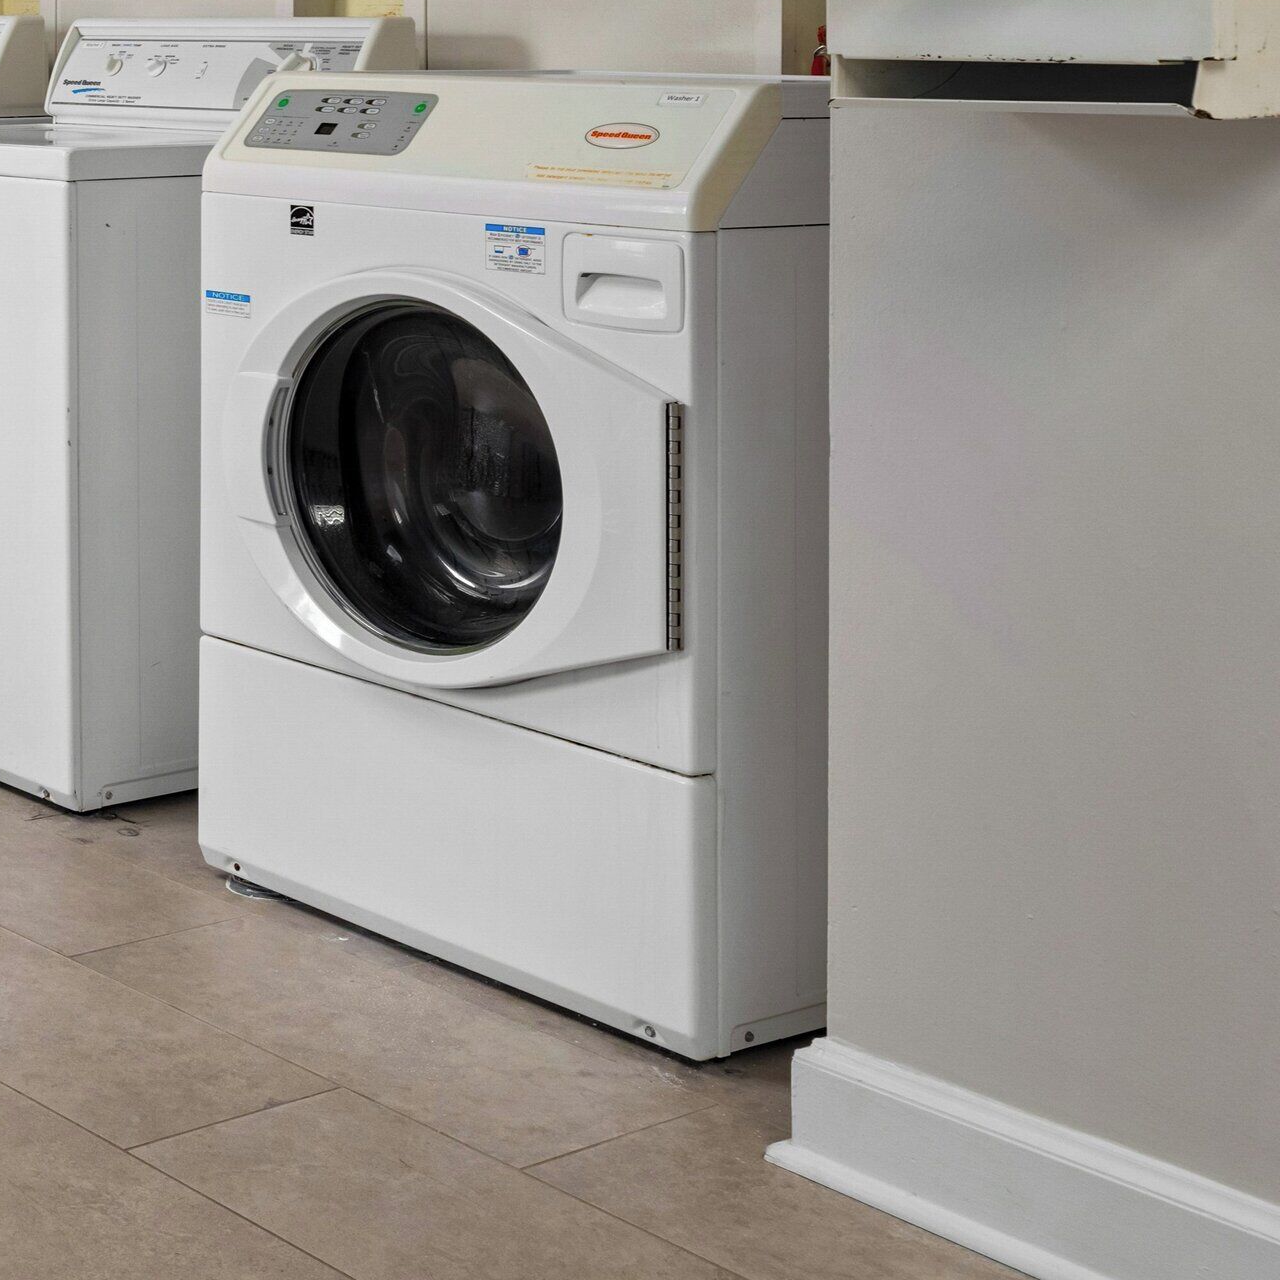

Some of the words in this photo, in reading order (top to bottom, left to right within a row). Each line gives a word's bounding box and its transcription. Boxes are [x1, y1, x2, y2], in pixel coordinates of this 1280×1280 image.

[63, 79, 82, 87] Speed
[666, 94, 694, 102] Washer
[590, 130, 621, 139] Speed
[621, 132, 652, 140] Queen
[212, 292, 242, 301] NOTICE
